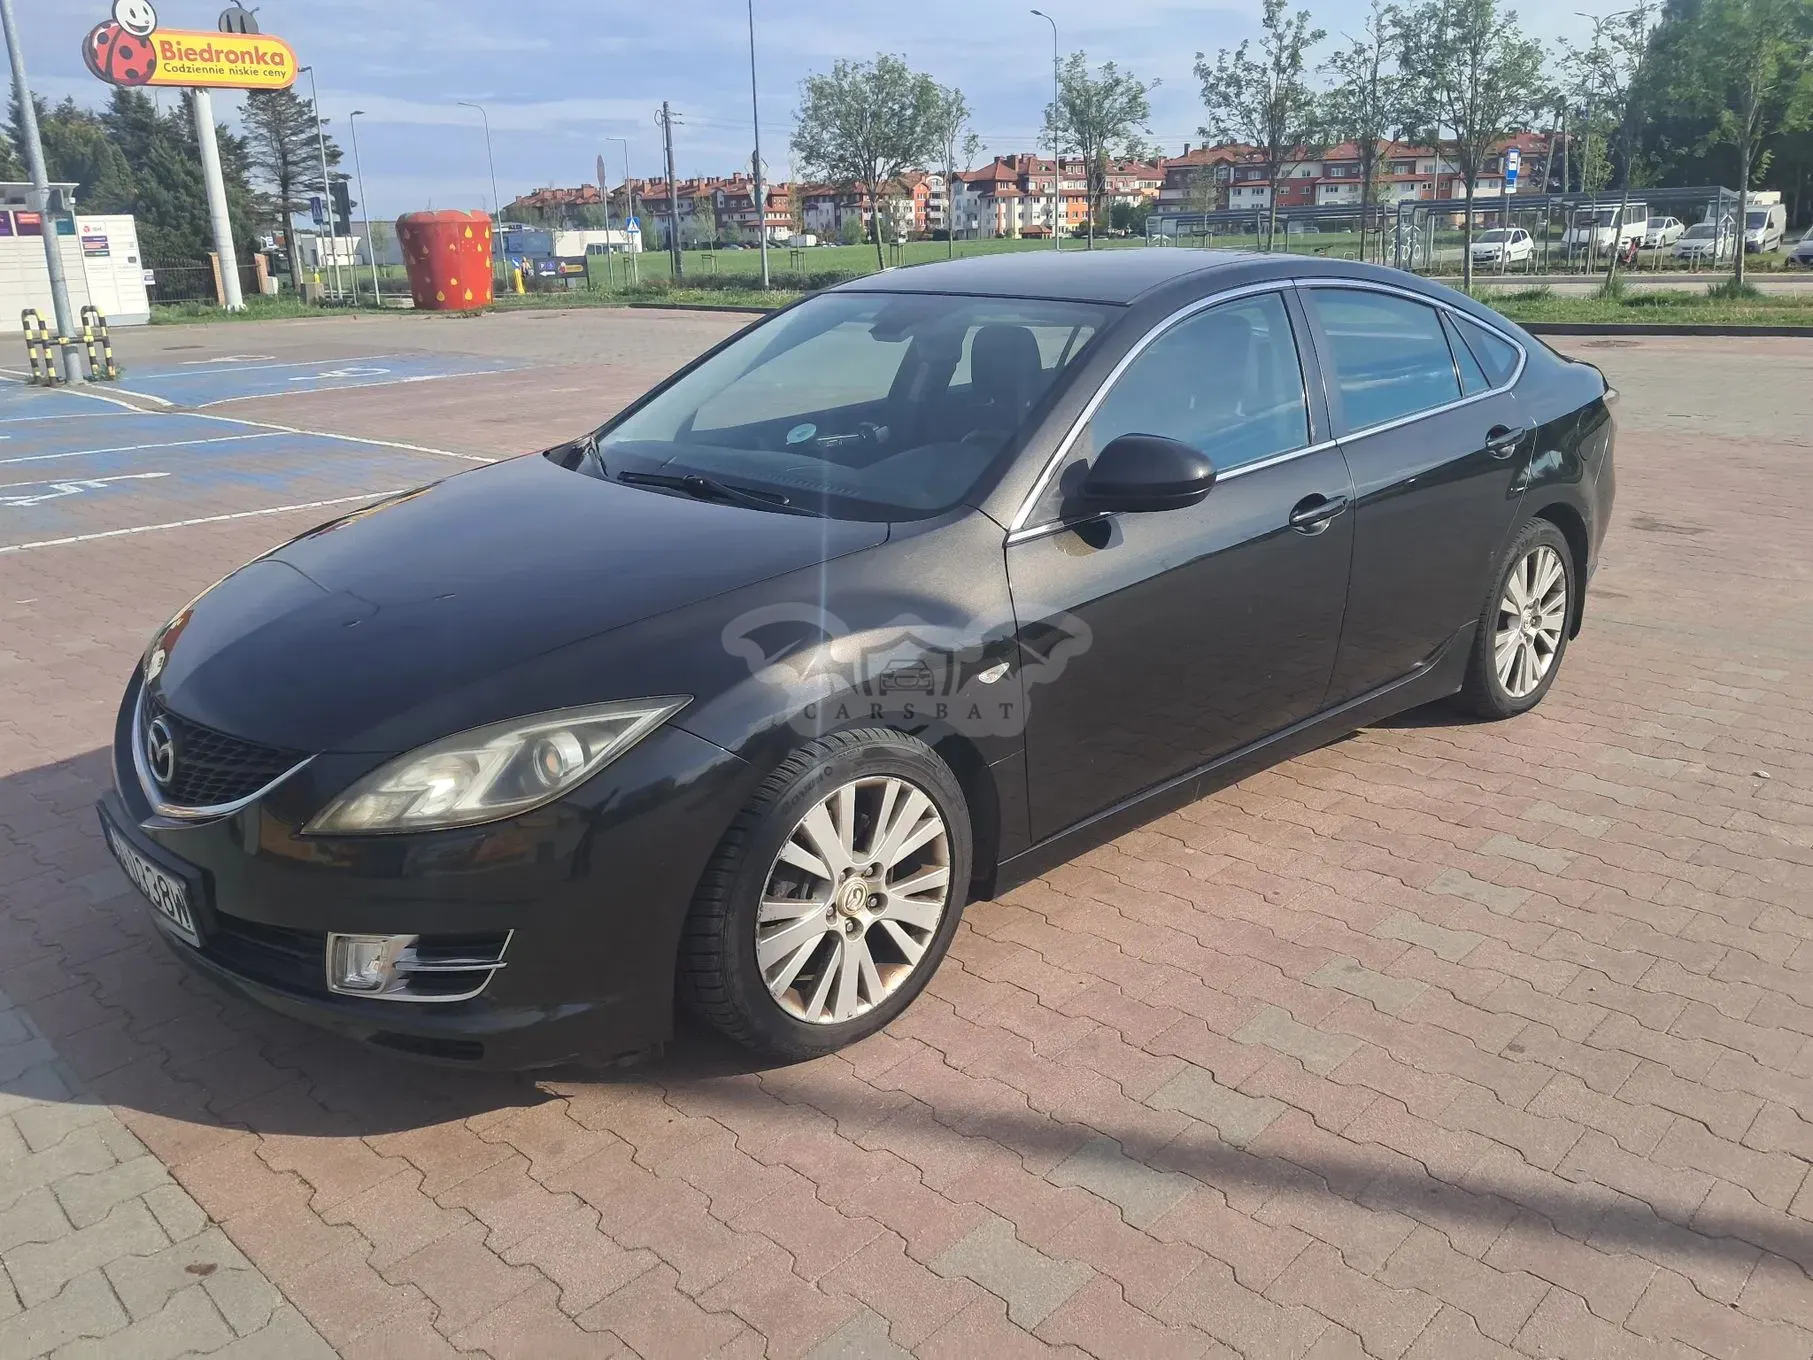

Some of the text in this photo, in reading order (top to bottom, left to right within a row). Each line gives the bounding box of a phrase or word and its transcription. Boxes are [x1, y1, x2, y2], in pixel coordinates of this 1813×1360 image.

[159, 40, 285, 66] Biedronka
[163, 62, 287, 79] Codziennie niskie ceny
